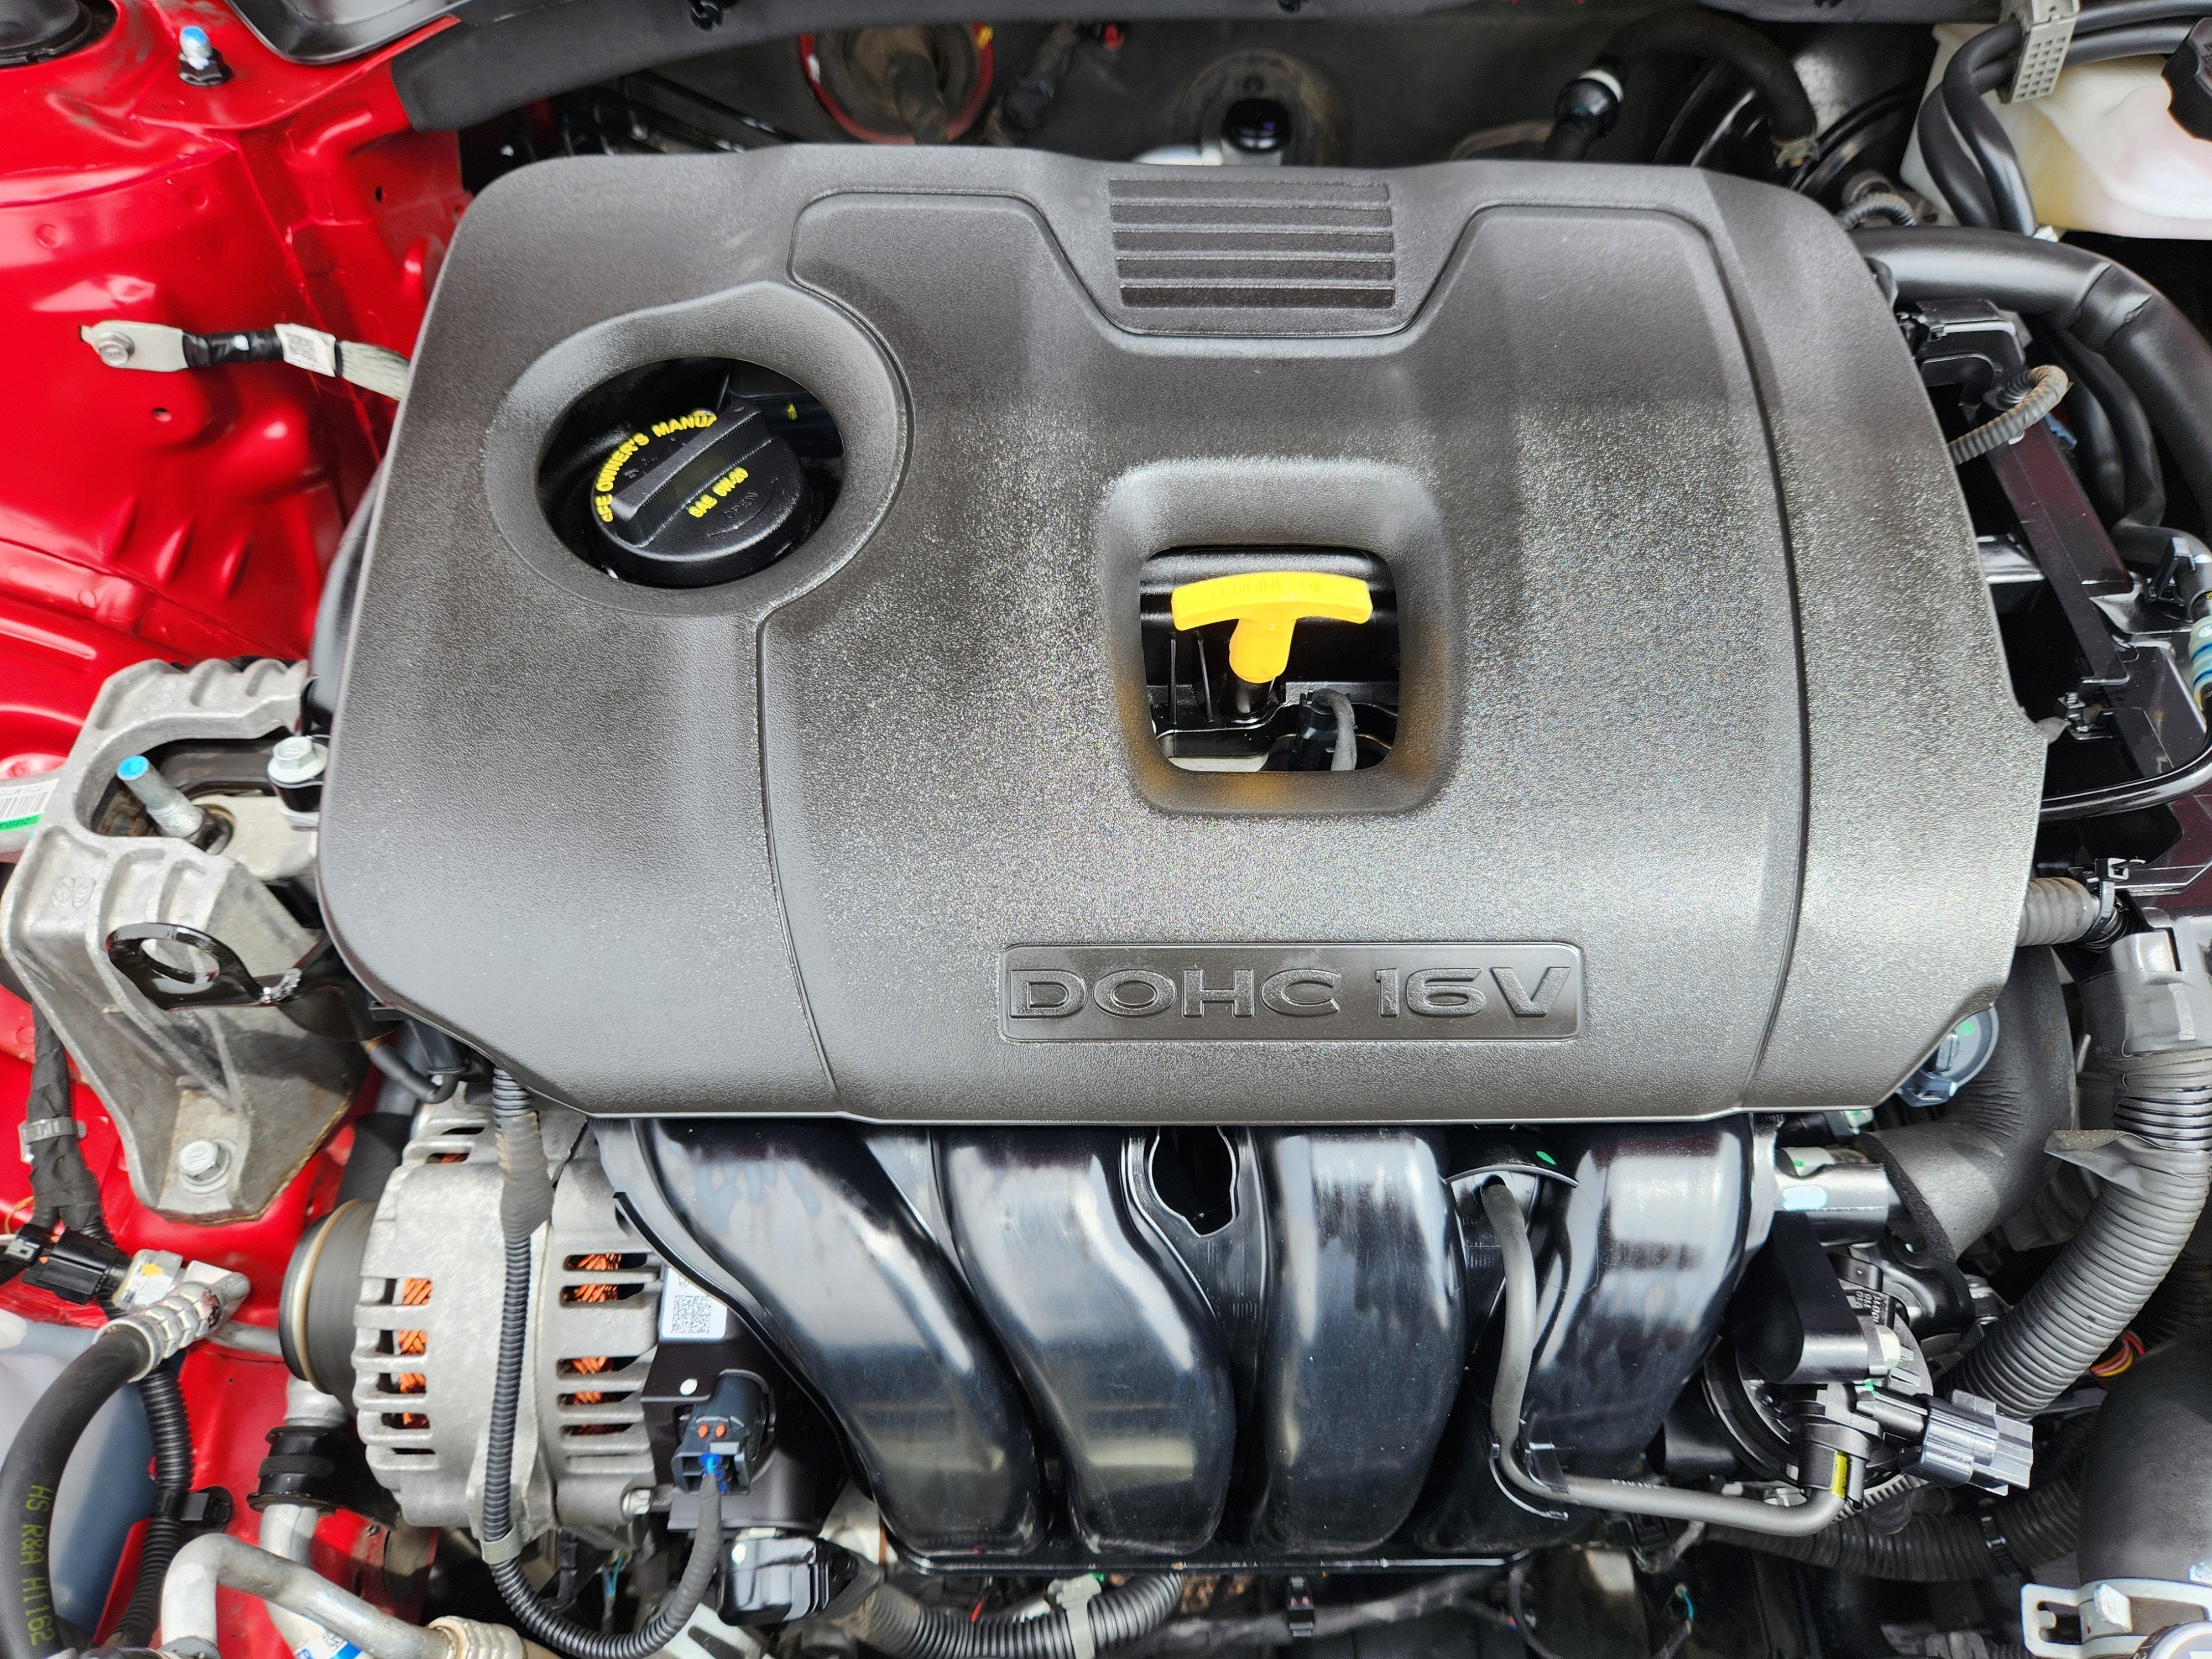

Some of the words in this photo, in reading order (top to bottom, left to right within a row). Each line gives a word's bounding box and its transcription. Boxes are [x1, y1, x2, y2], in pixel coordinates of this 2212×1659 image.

[596, 432, 650, 492] OWNER'S
[595, 493, 613, 523] SEE
[688, 493, 718, 518] SAE
[724, 491, 758, 520] OPEN
[1220, 578, 1289, 597] ENGINE
[1301, 578, 1321, 593] OIL
[1009, 968, 1340, 1018] DOHC
[1375, 966, 1571, 1018] 16V
[25, 1484, 54, 1512] HS
[20, 1524, 47, 1566] R&A
